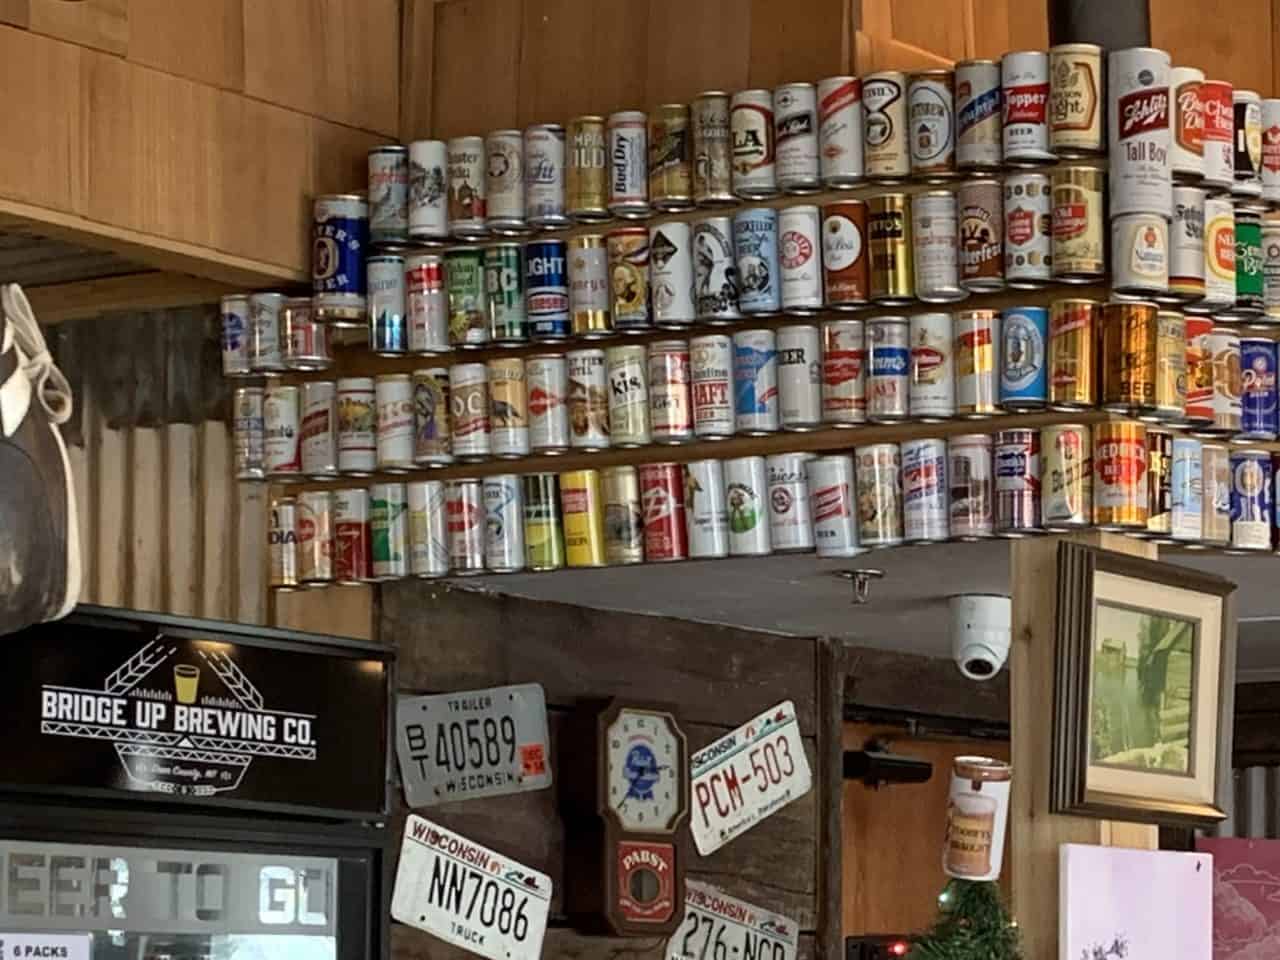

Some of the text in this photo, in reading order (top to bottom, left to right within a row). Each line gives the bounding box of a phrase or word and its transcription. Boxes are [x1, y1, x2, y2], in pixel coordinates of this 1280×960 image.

[1126, 143, 1168, 165] Tall Boy
[447, 697, 493, 713] TRAILER
[41, 689, 318, 747] BRIDGE UP BREWING CO.
[435, 715, 517, 773] 40589
[445, 771, 516, 794] WISCONSIN
[696, 734, 795, 830] PCM-503
[411, 820, 490, 871] WISCONSIN
[621, 849, 670, 872] PABST
[429, 855, 530, 942] NN7086
[450, 922, 486, 946] TRUCK
[13, 945, 68, 958] 6 PACKS
